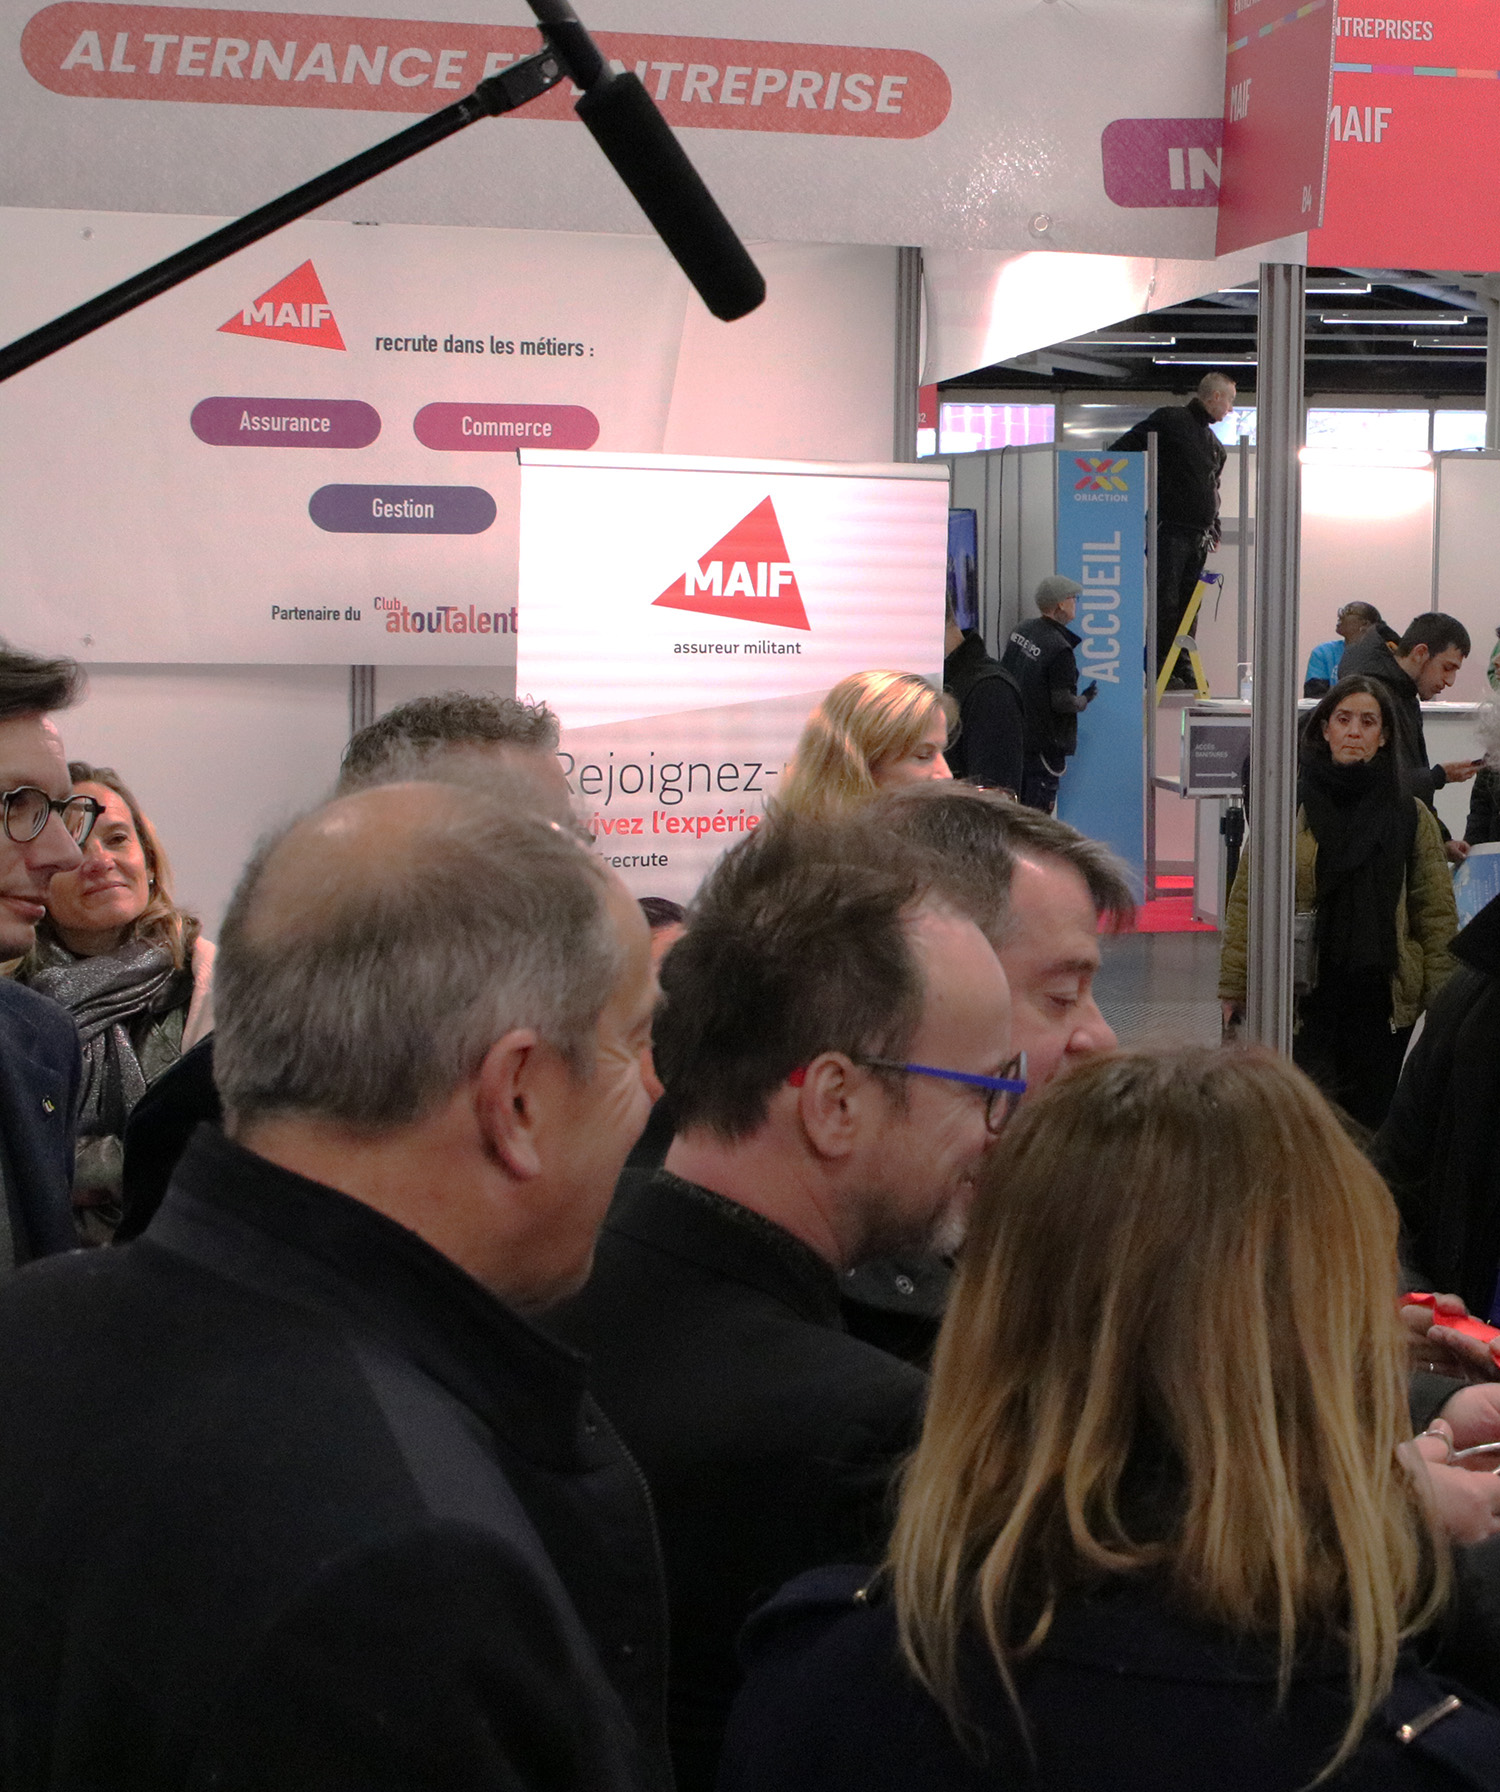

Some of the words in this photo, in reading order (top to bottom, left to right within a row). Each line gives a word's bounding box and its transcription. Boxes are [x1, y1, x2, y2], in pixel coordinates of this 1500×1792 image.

[59, 29, 468, 91] ALTERNANCE
[1230, 78, 1252, 123] MAIF
[1301, 184, 1313, 214] B4
[241, 302, 332, 329] MAIF
[375, 334, 440, 355] recrute
[443, 335, 484, 356] dans
[489, 336, 515, 357] les
[519, 336, 584, 358] métiers
[239, 411, 330, 433] Assurance
[461, 416, 552, 438] Commerce
[372, 497, 435, 523] Gestion
[684, 561, 794, 598] MAIF
[271, 604, 341, 621] Partenaire
[344, 606, 361, 621] du
[374, 597, 401, 611] Club
[1081, 531, 1121, 684] ACCUEIL
[385, 604, 518, 634] atouTalent
[673, 640, 740, 656] assureur
[743, 638, 802, 656] militant
